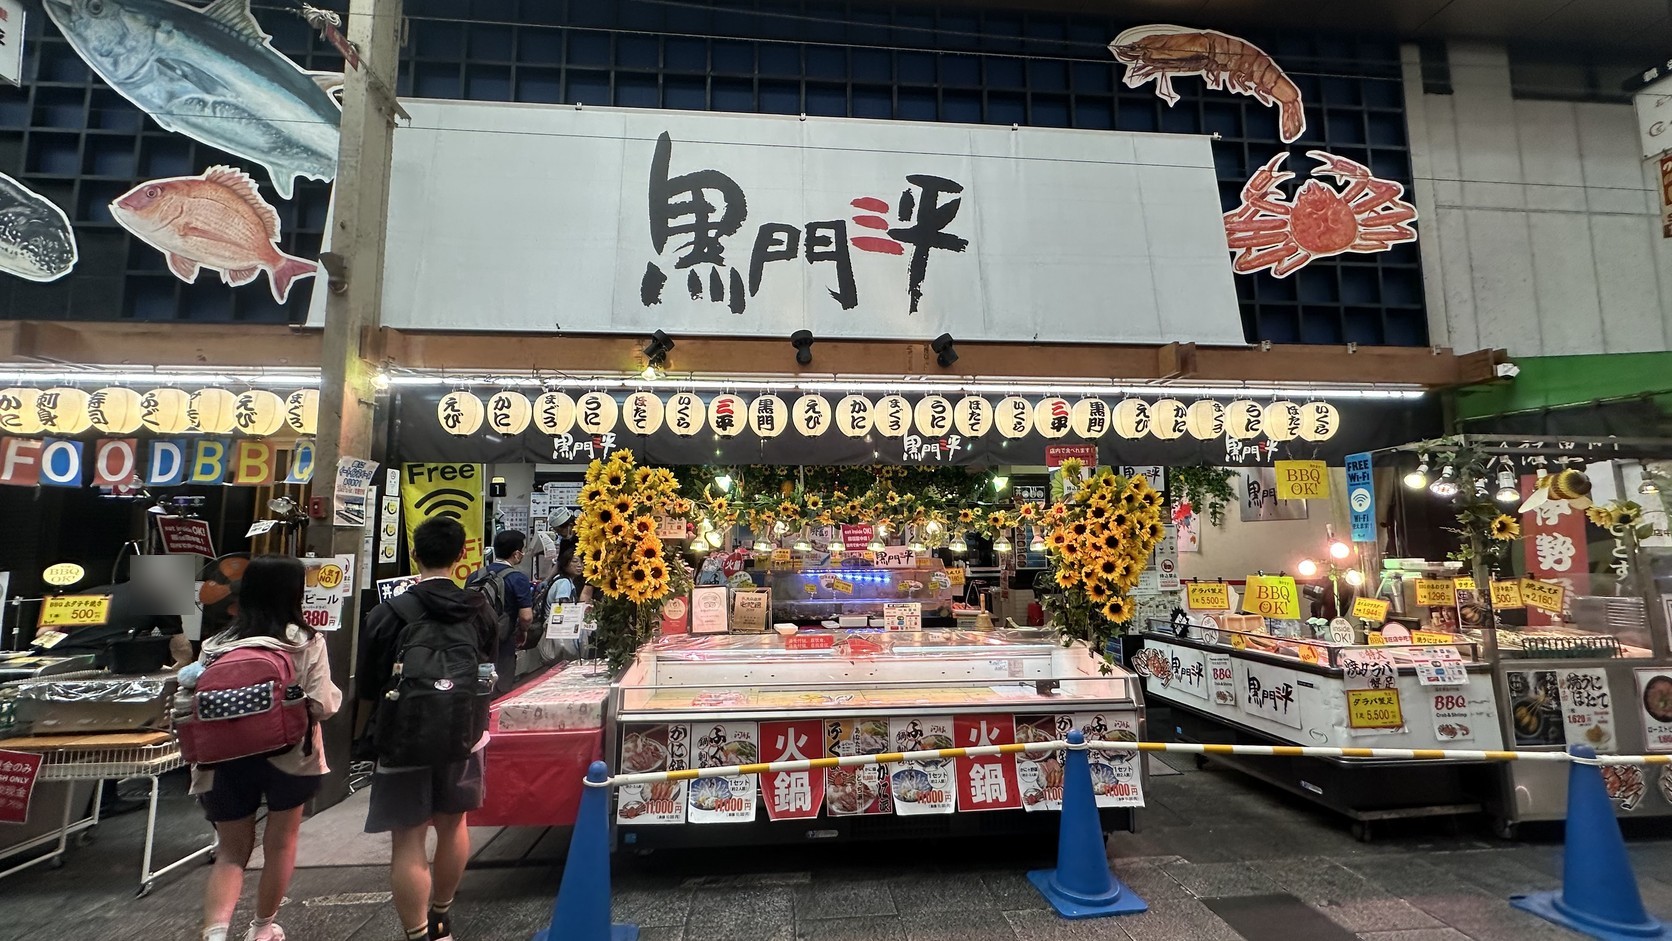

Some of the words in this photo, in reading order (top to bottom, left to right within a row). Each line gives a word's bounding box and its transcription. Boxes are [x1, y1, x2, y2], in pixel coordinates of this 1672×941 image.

[641, 130, 969, 316] 黒門三平
[36, 392, 60, 427] 刺身
[140, 393, 160, 426] ふぐ
[236, 394, 258, 429] えび
[288, 393, 305, 429] まぐろ
[443, 397, 464, 429] えび
[493, 395, 512, 428] かに
[543, 395, 560, 429] まぐろ
[584, 396, 601, 426] うに
[633, 396, 648, 429] ほたて
[676, 396, 692, 429] いくら
[715, 398, 735, 431] 三平
[756, 398, 775, 432] 黒門
[804, 399, 823, 430] えび
[850, 399, 868, 430] かに
[888, 398, 904, 431] まぐろ
[930, 400, 947, 429] うに
[968, 400, 983, 432] ほたて
[1013, 400, 1026, 433] いくら
[1050, 400, 1069, 433] 三平
[1086, 401, 1106, 434] 黒門
[1134, 403, 1151, 433] えび
[1172, 404, 1188, 433] かに
[1212, 403, 1226, 434] まぐろ
[1244, 404, 1262, 432] うに
[1287, 405, 1300, 435] ほたて
[1313, 405, 1330, 435] いくら
[407, 463, 475, 485] Free
[1286, 468, 1321, 484] BBQ
[1347, 459, 1370, 472] FREE
[1348, 472, 1370, 483] Wi-Fi
[1290, 482, 1319, 495] OK!
[49, 568, 80, 576] BBQ
[305, 594, 339, 605] ビール
[1256, 585, 1291, 603] BBQ
[1259, 600, 1289, 615] OK!
[1334, 632, 1352, 643] OK!
[1212, 667, 1232, 680] BBQ
[1246, 667, 1295, 715] 黒門三平
[1434, 695, 1467, 710] BBQ
[1572, 691, 1609, 709] ほたて
[0, 760, 32, 774] 金のみ
[773, 727, 812, 813] 火鍋
[968, 720, 1008, 804] 火鍋
[9, 775, 30, 784] ONLY
